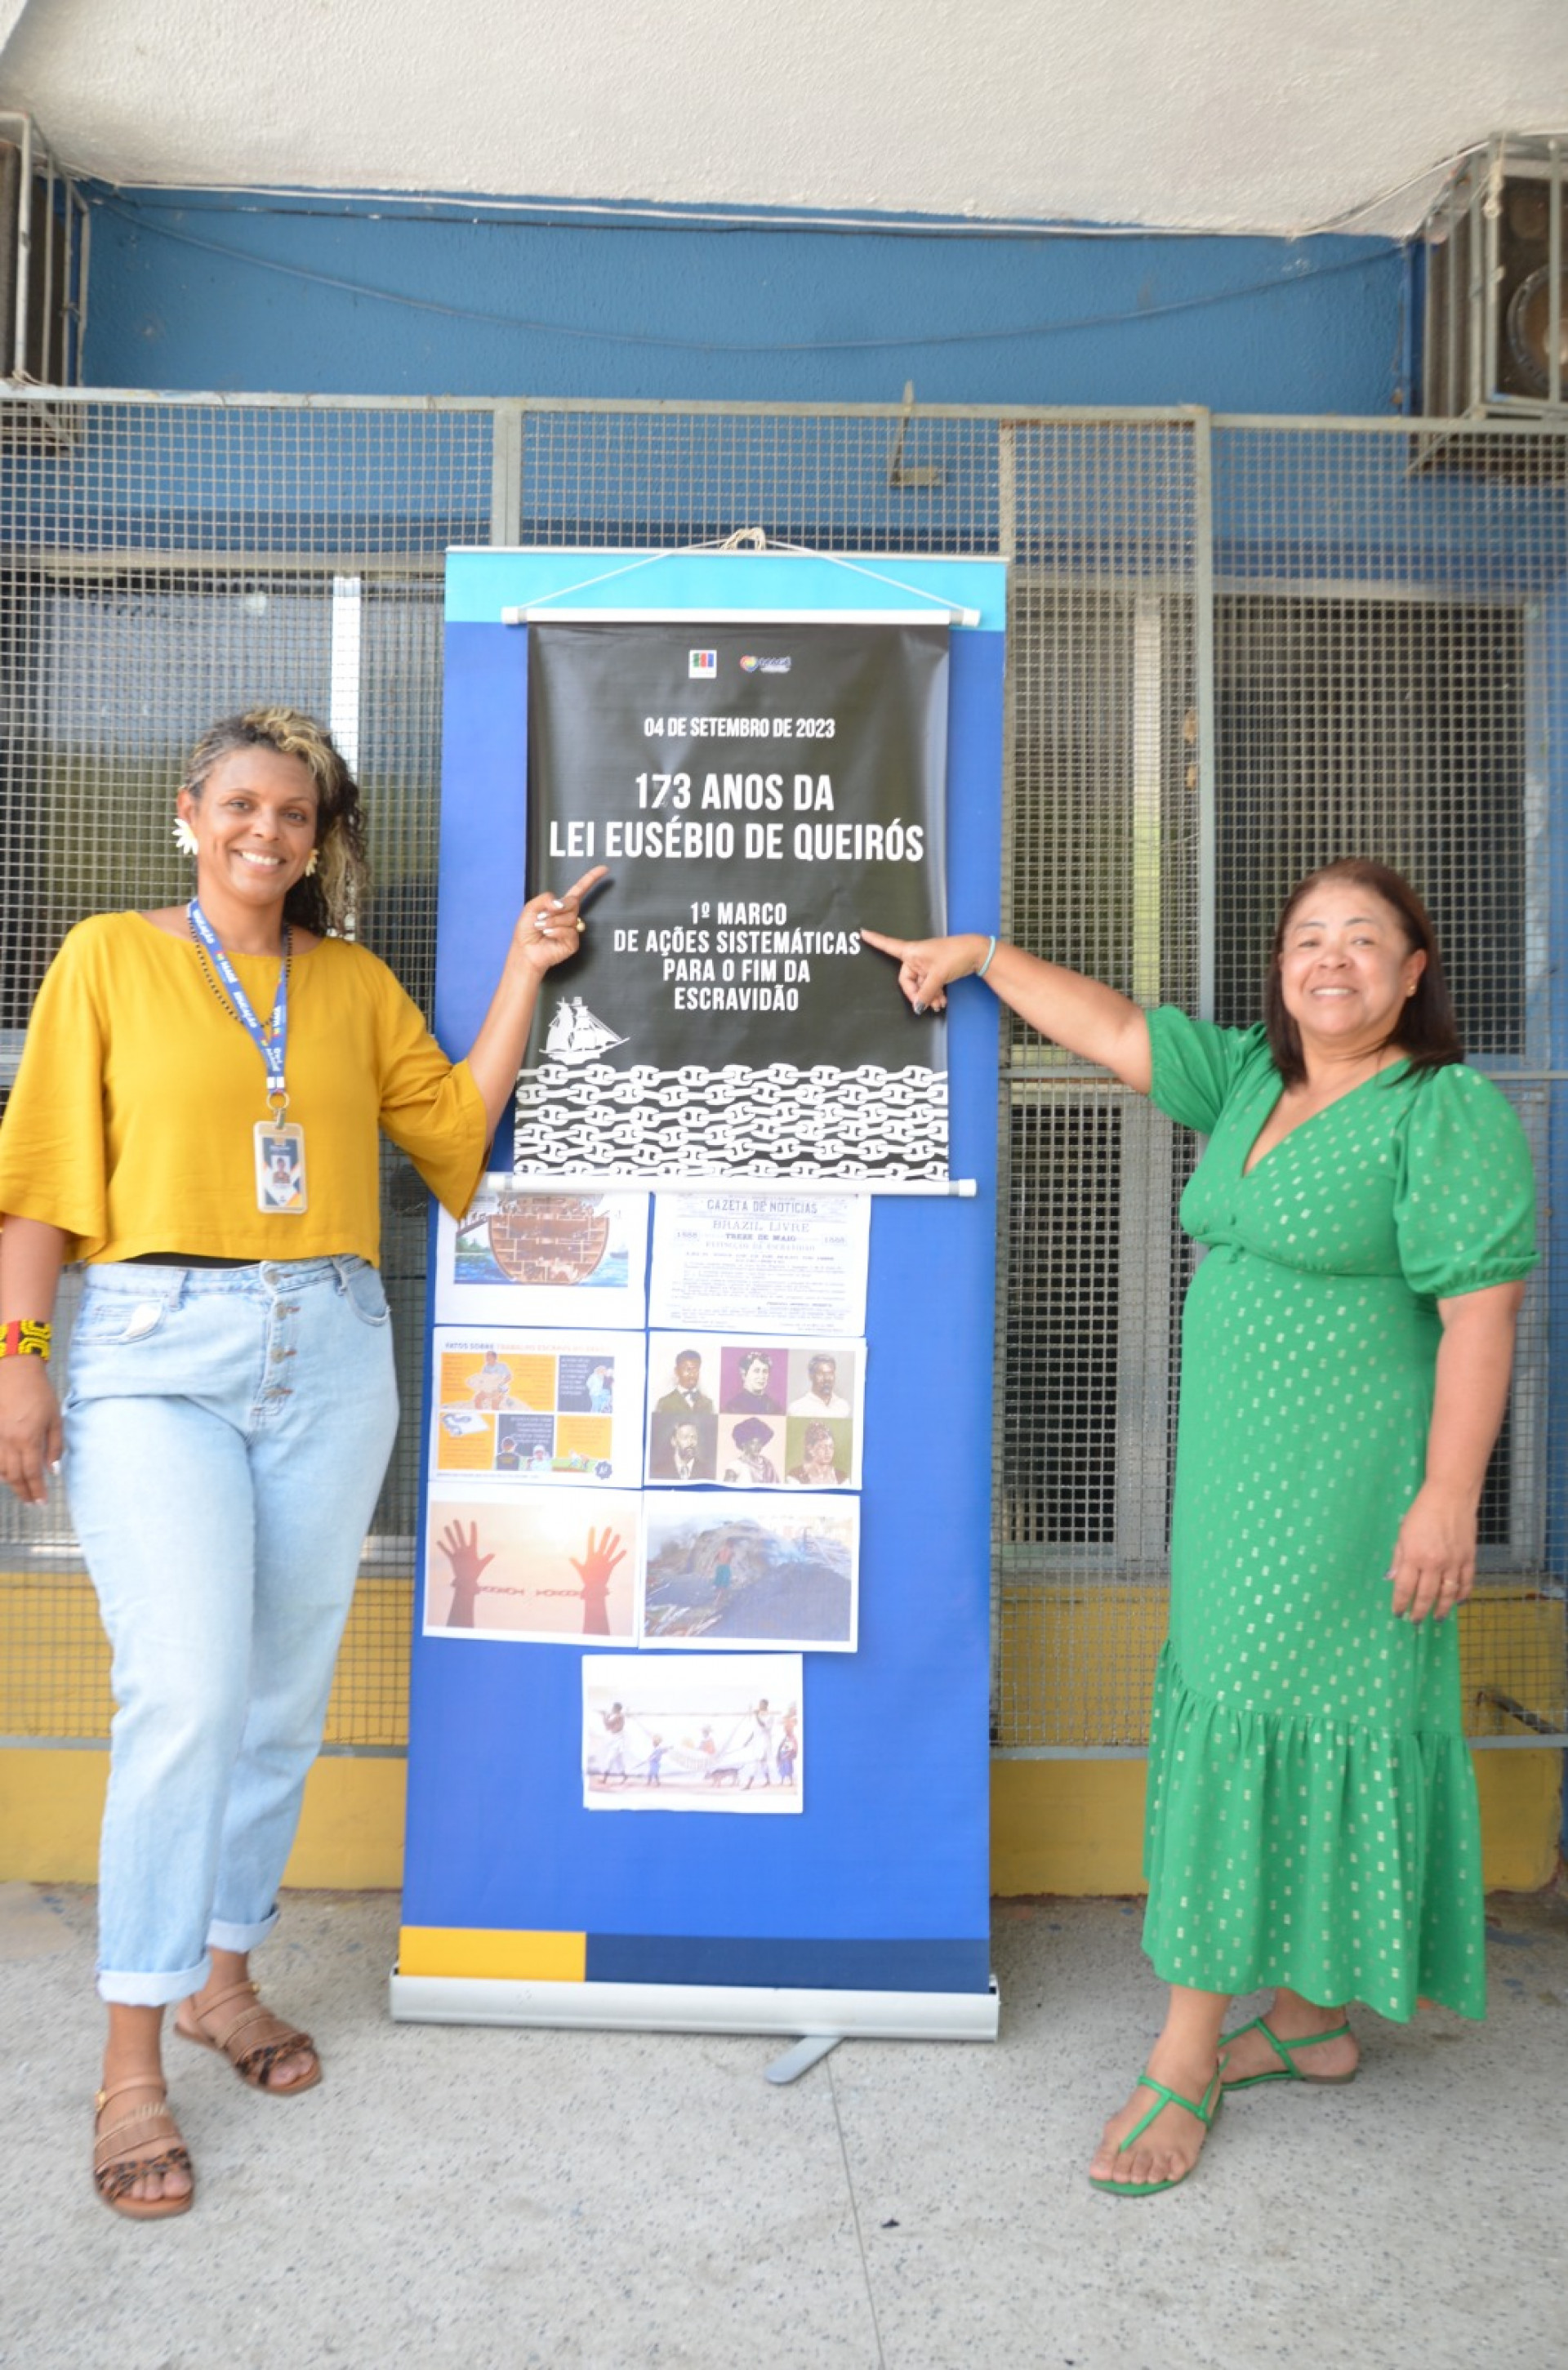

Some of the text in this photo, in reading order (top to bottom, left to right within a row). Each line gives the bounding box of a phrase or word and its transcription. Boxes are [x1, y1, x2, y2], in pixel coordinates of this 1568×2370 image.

[644, 717, 835, 738] 04 DE SETEMBRO DE 2023
[635, 773, 835, 811] 173 ANOS DA
[550, 815, 924, 862] LEI EUSÉBIO DE QUEIRÓS
[689, 902, 787, 926] 1º MARCO
[613, 927, 860, 956] DE AÇÕES SISTEMÁTICAS
[662, 959, 811, 983] PARA O FIM DA
[674, 984, 799, 1011] ESCRAVIDÃO
[769, 1221, 810, 1233] LIVRE
